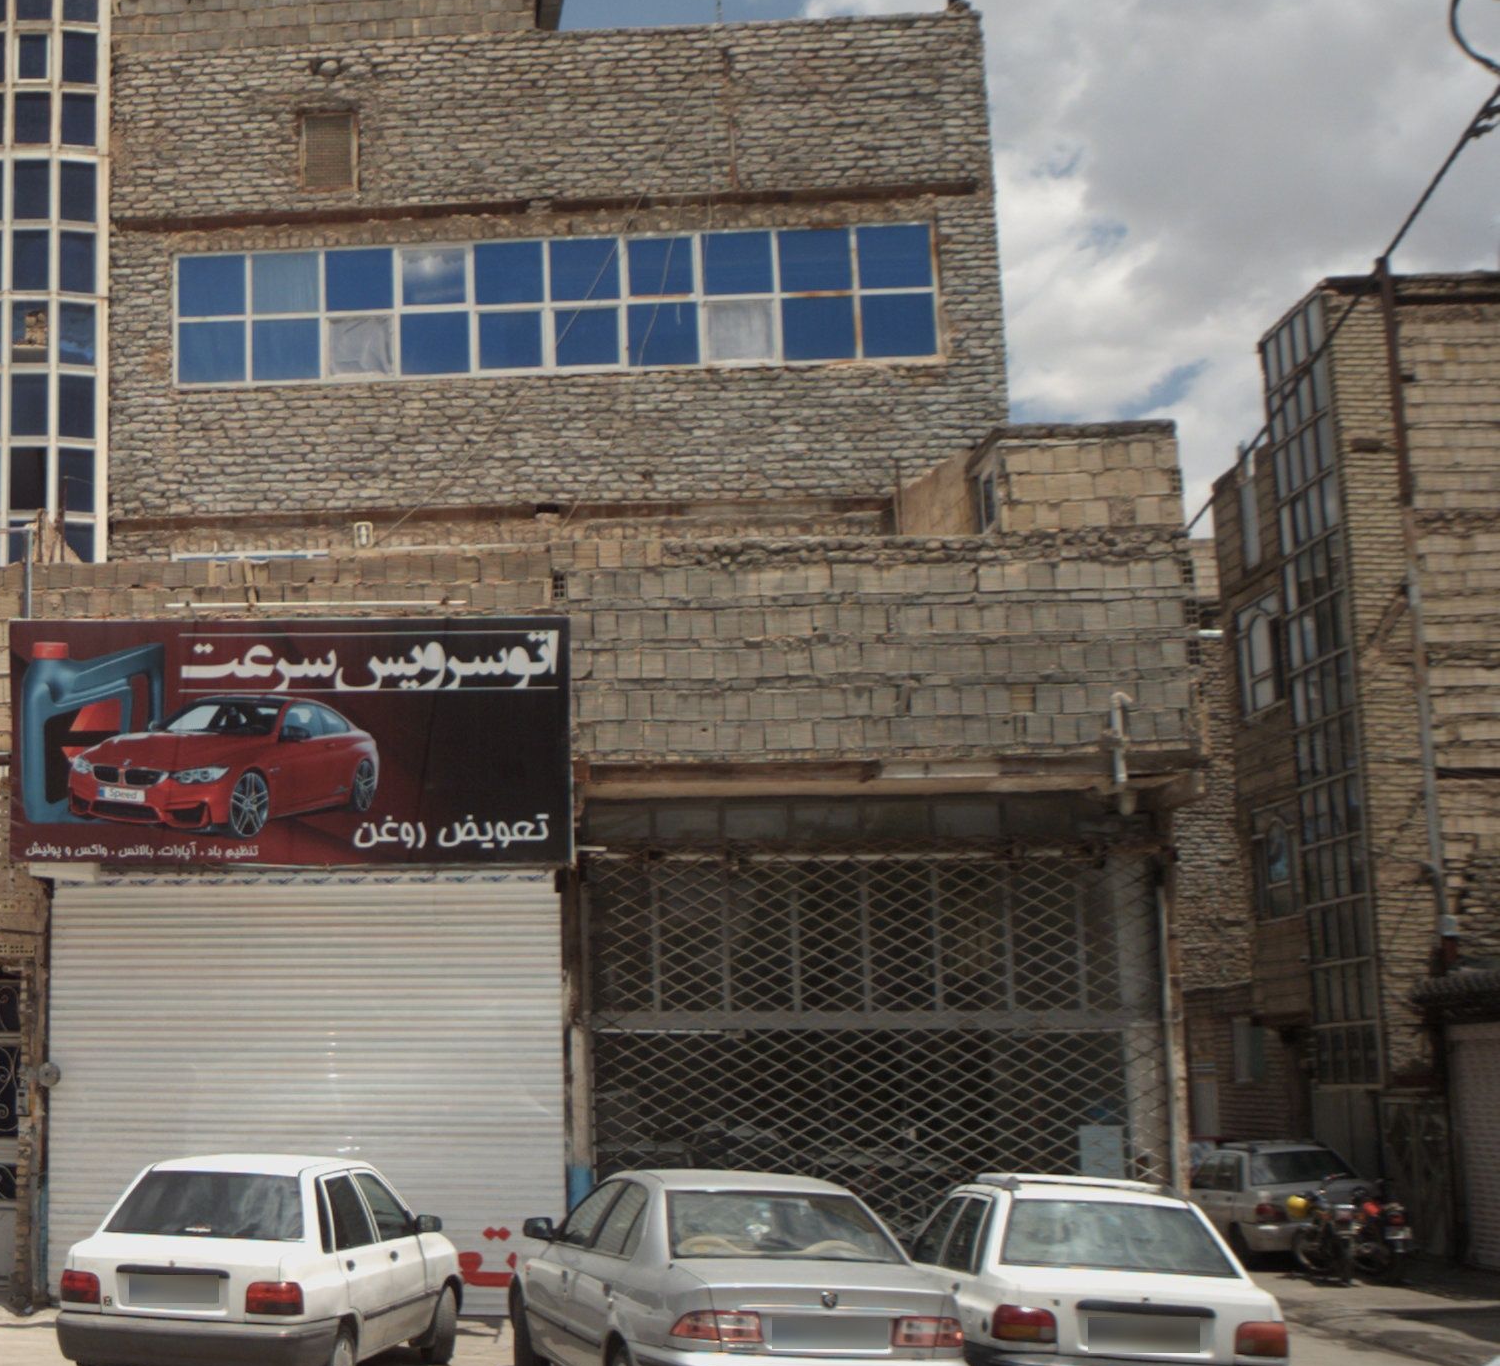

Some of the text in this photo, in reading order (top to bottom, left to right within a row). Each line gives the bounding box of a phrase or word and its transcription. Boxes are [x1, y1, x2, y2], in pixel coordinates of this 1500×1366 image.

[180, 643, 338, 691] سرعت
[353, 813, 550, 849] تعویض روغن
[225, 844, 259, 859] تنظیم
